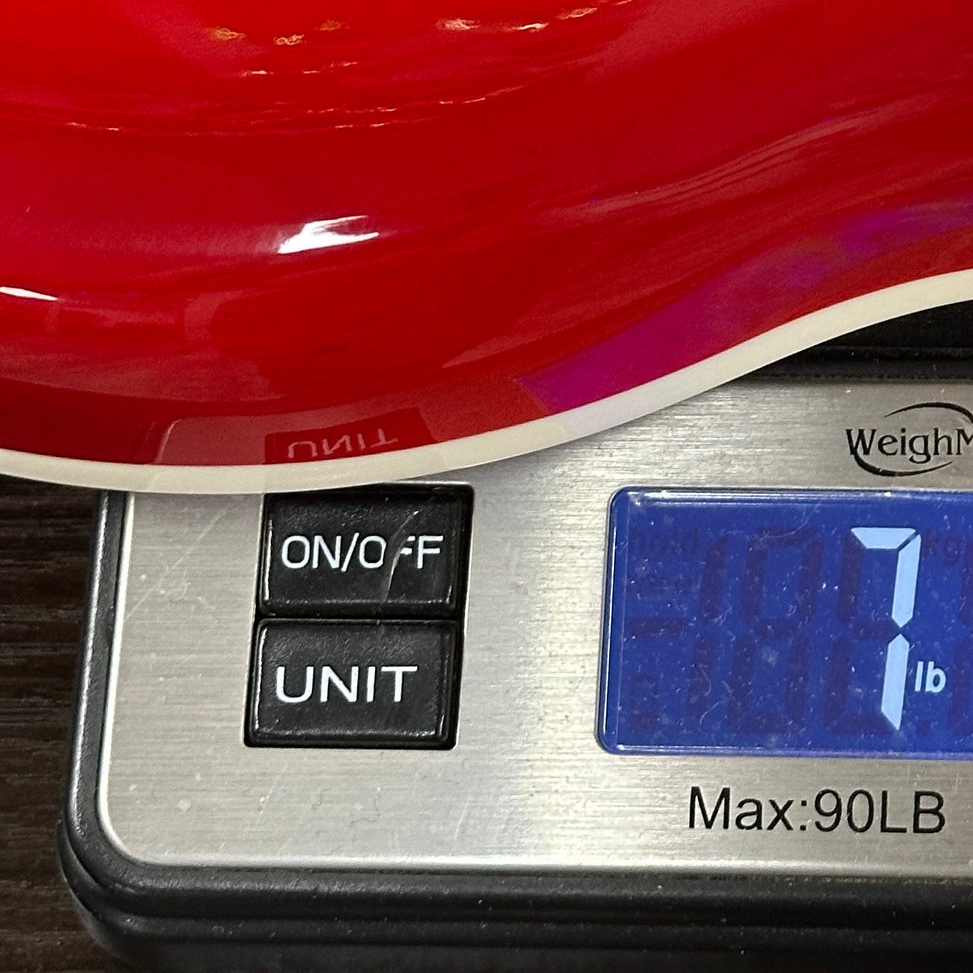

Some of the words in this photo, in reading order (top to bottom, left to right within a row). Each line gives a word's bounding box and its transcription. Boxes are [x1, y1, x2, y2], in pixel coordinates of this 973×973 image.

[851, 527, 921, 730] 7
[914, 661, 947, 694] lb
[275, 666, 418, 704] UNIT
[688, 787, 946, 835] Max:90LB
